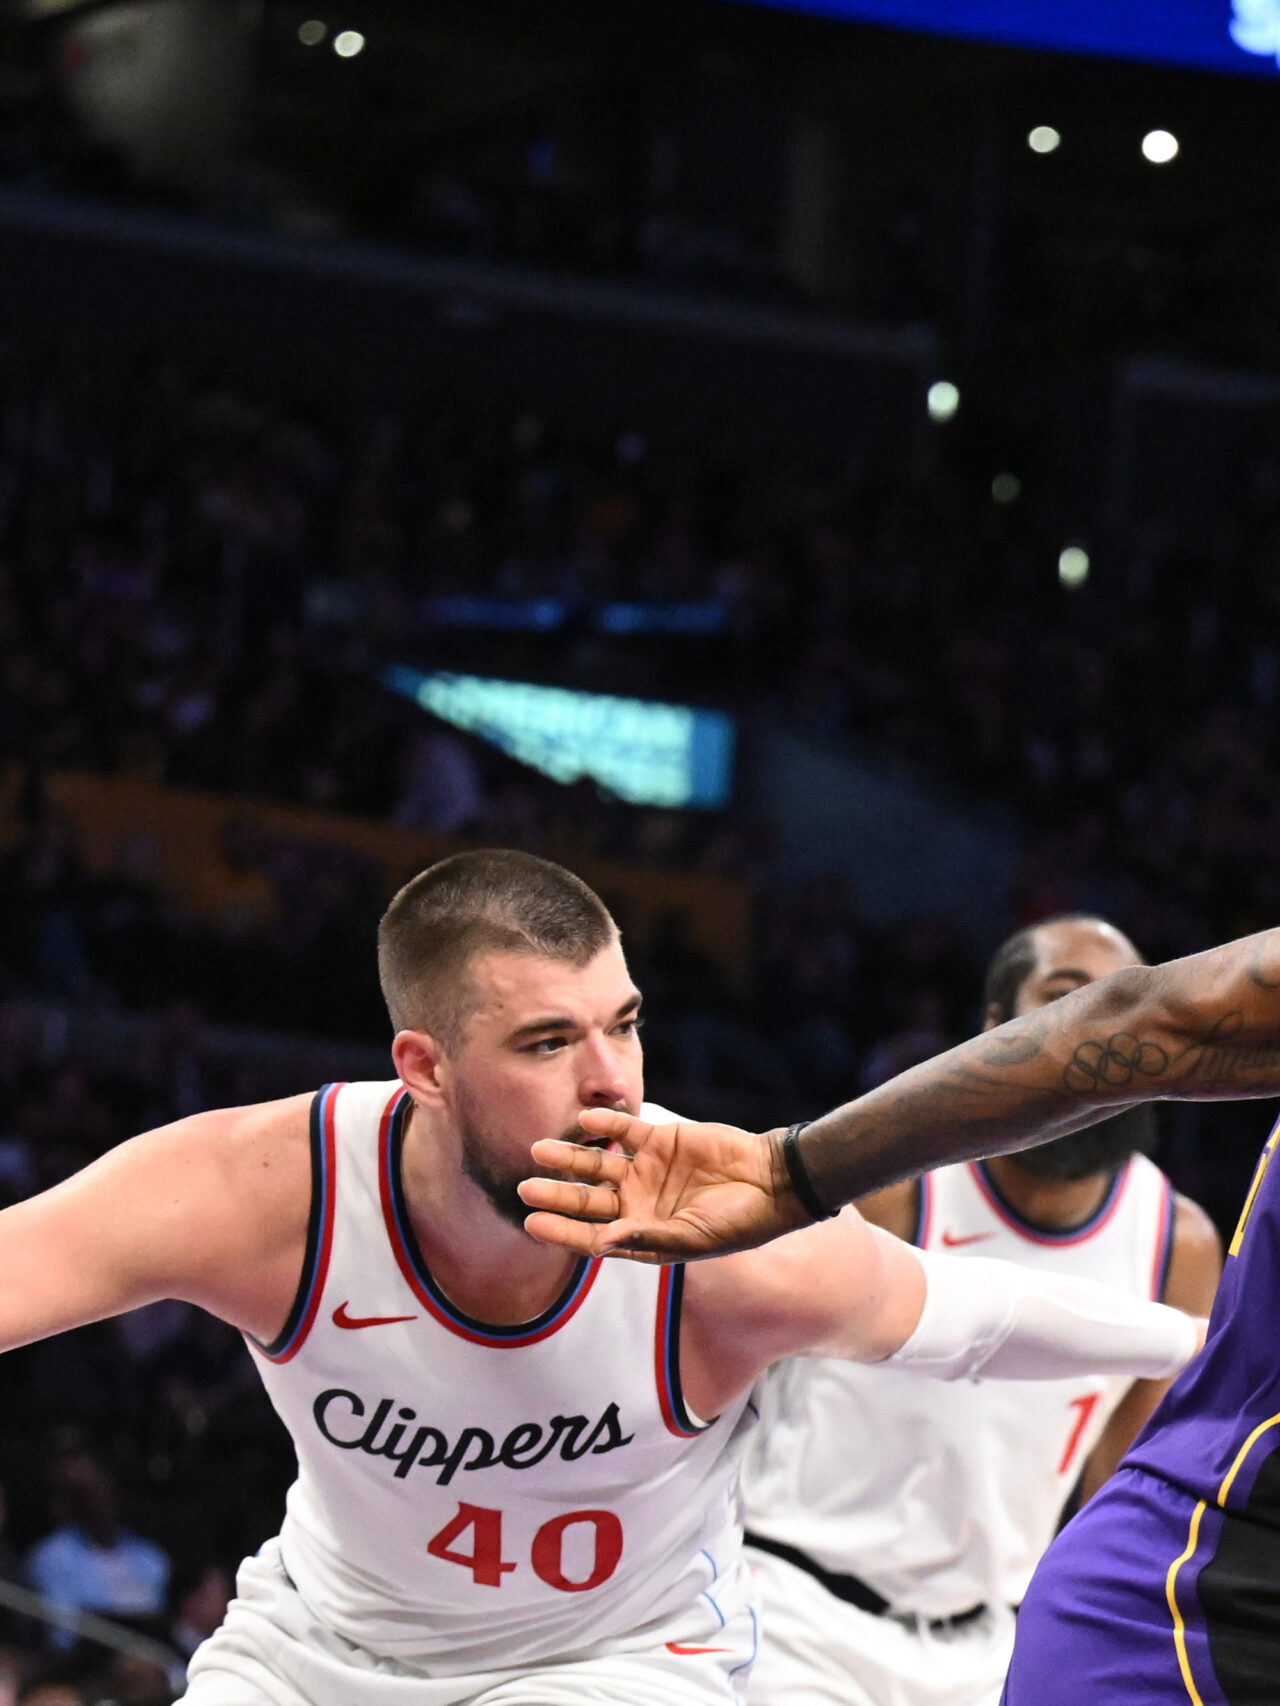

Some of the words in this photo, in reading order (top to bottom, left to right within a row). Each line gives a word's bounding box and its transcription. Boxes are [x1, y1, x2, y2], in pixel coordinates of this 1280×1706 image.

[313, 1388, 635, 1486] Clippers
[1058, 1391, 1100, 1475] 1
[427, 1501, 624, 1593] 40
